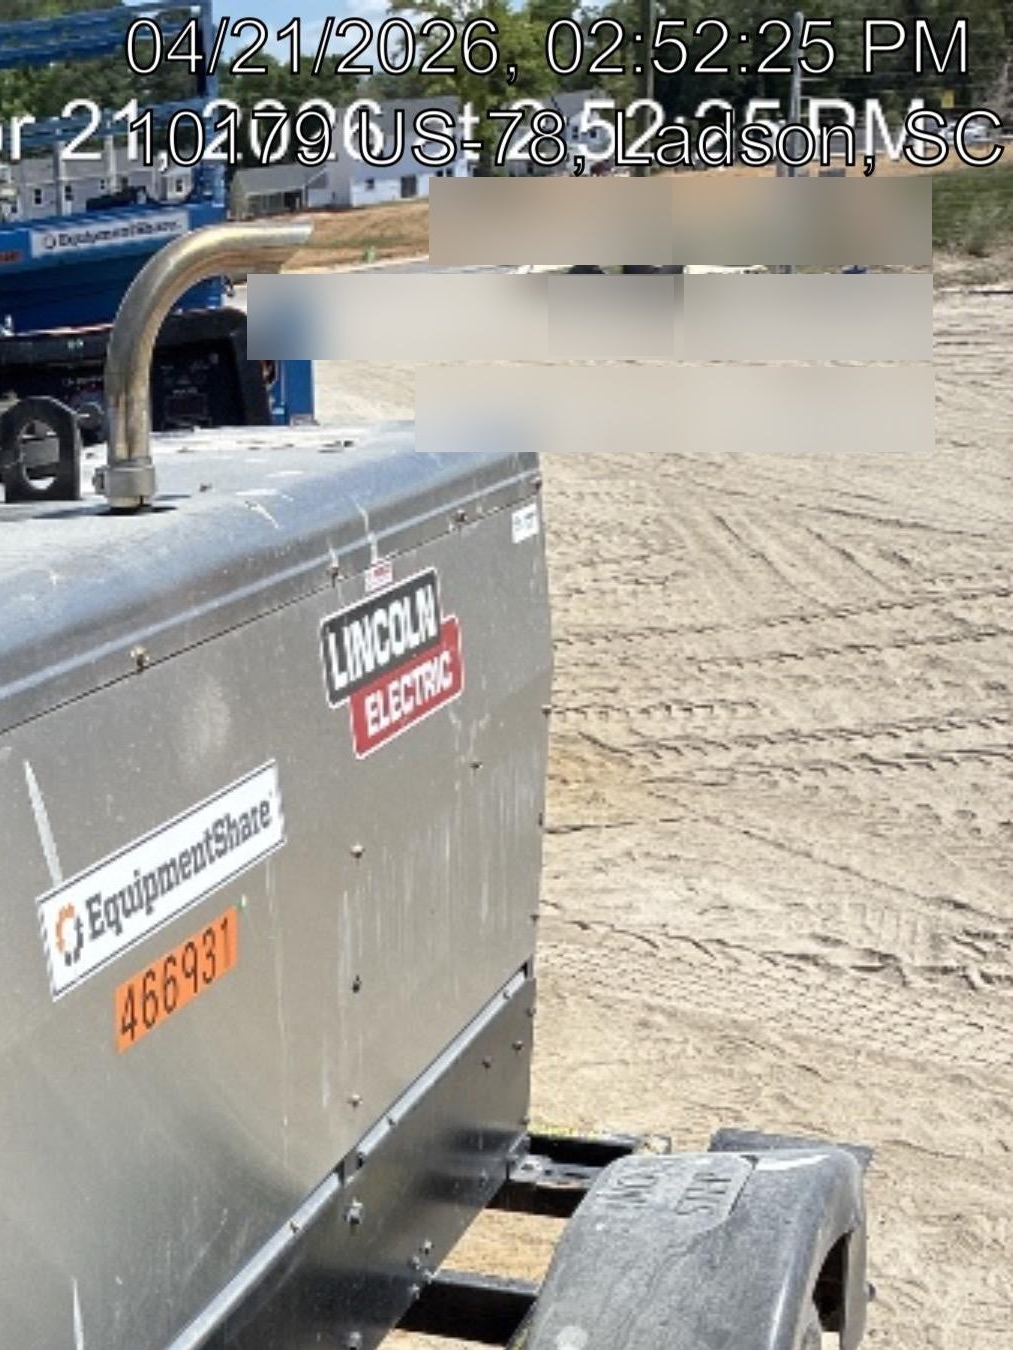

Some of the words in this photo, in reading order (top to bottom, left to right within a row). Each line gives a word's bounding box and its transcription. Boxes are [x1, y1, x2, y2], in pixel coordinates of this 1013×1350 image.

[328, 584, 438, 691] LINCOLN
[364, 650, 454, 737] ELECTRIC
[84, 799, 272, 940] EquipmentShare
[120, 917, 230, 1042] 466931
